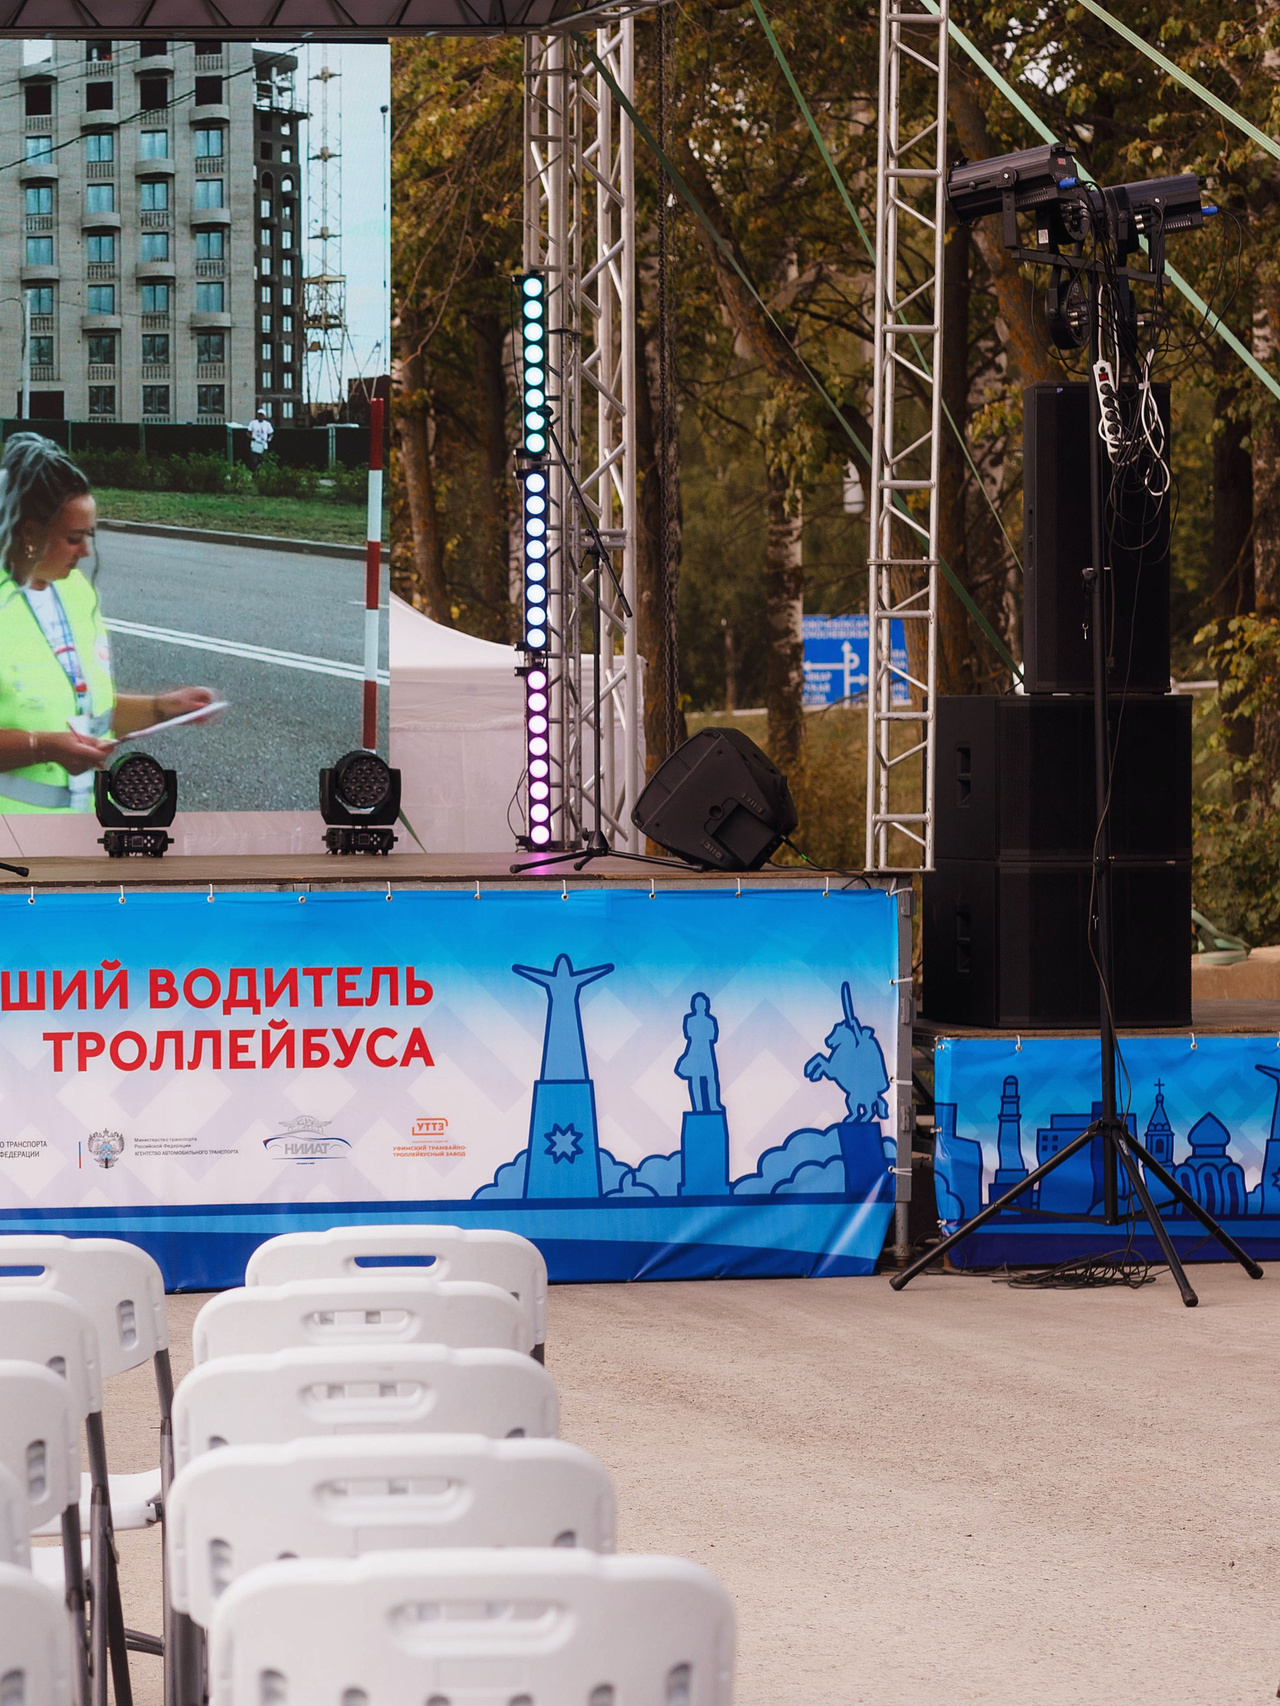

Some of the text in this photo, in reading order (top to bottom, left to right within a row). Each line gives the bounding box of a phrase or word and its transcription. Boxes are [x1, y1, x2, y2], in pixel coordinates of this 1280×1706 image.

[149, 966, 434, 1015] ВОДИТЕЛЬ
[42, 1019, 435, 1073] ТРОЛЛЕЙБУСА
[416, 1122, 444, 1131] УТТЗ
[6, 1140, 48, 1149] ТРАНСПОРТА
[284, 1142, 330, 1155] НИИАТ
[428, 1143, 467, 1151] ТРАМВАЙНО-
[0, 1150, 40, 1159] ФЕДЕРАЦИИ
